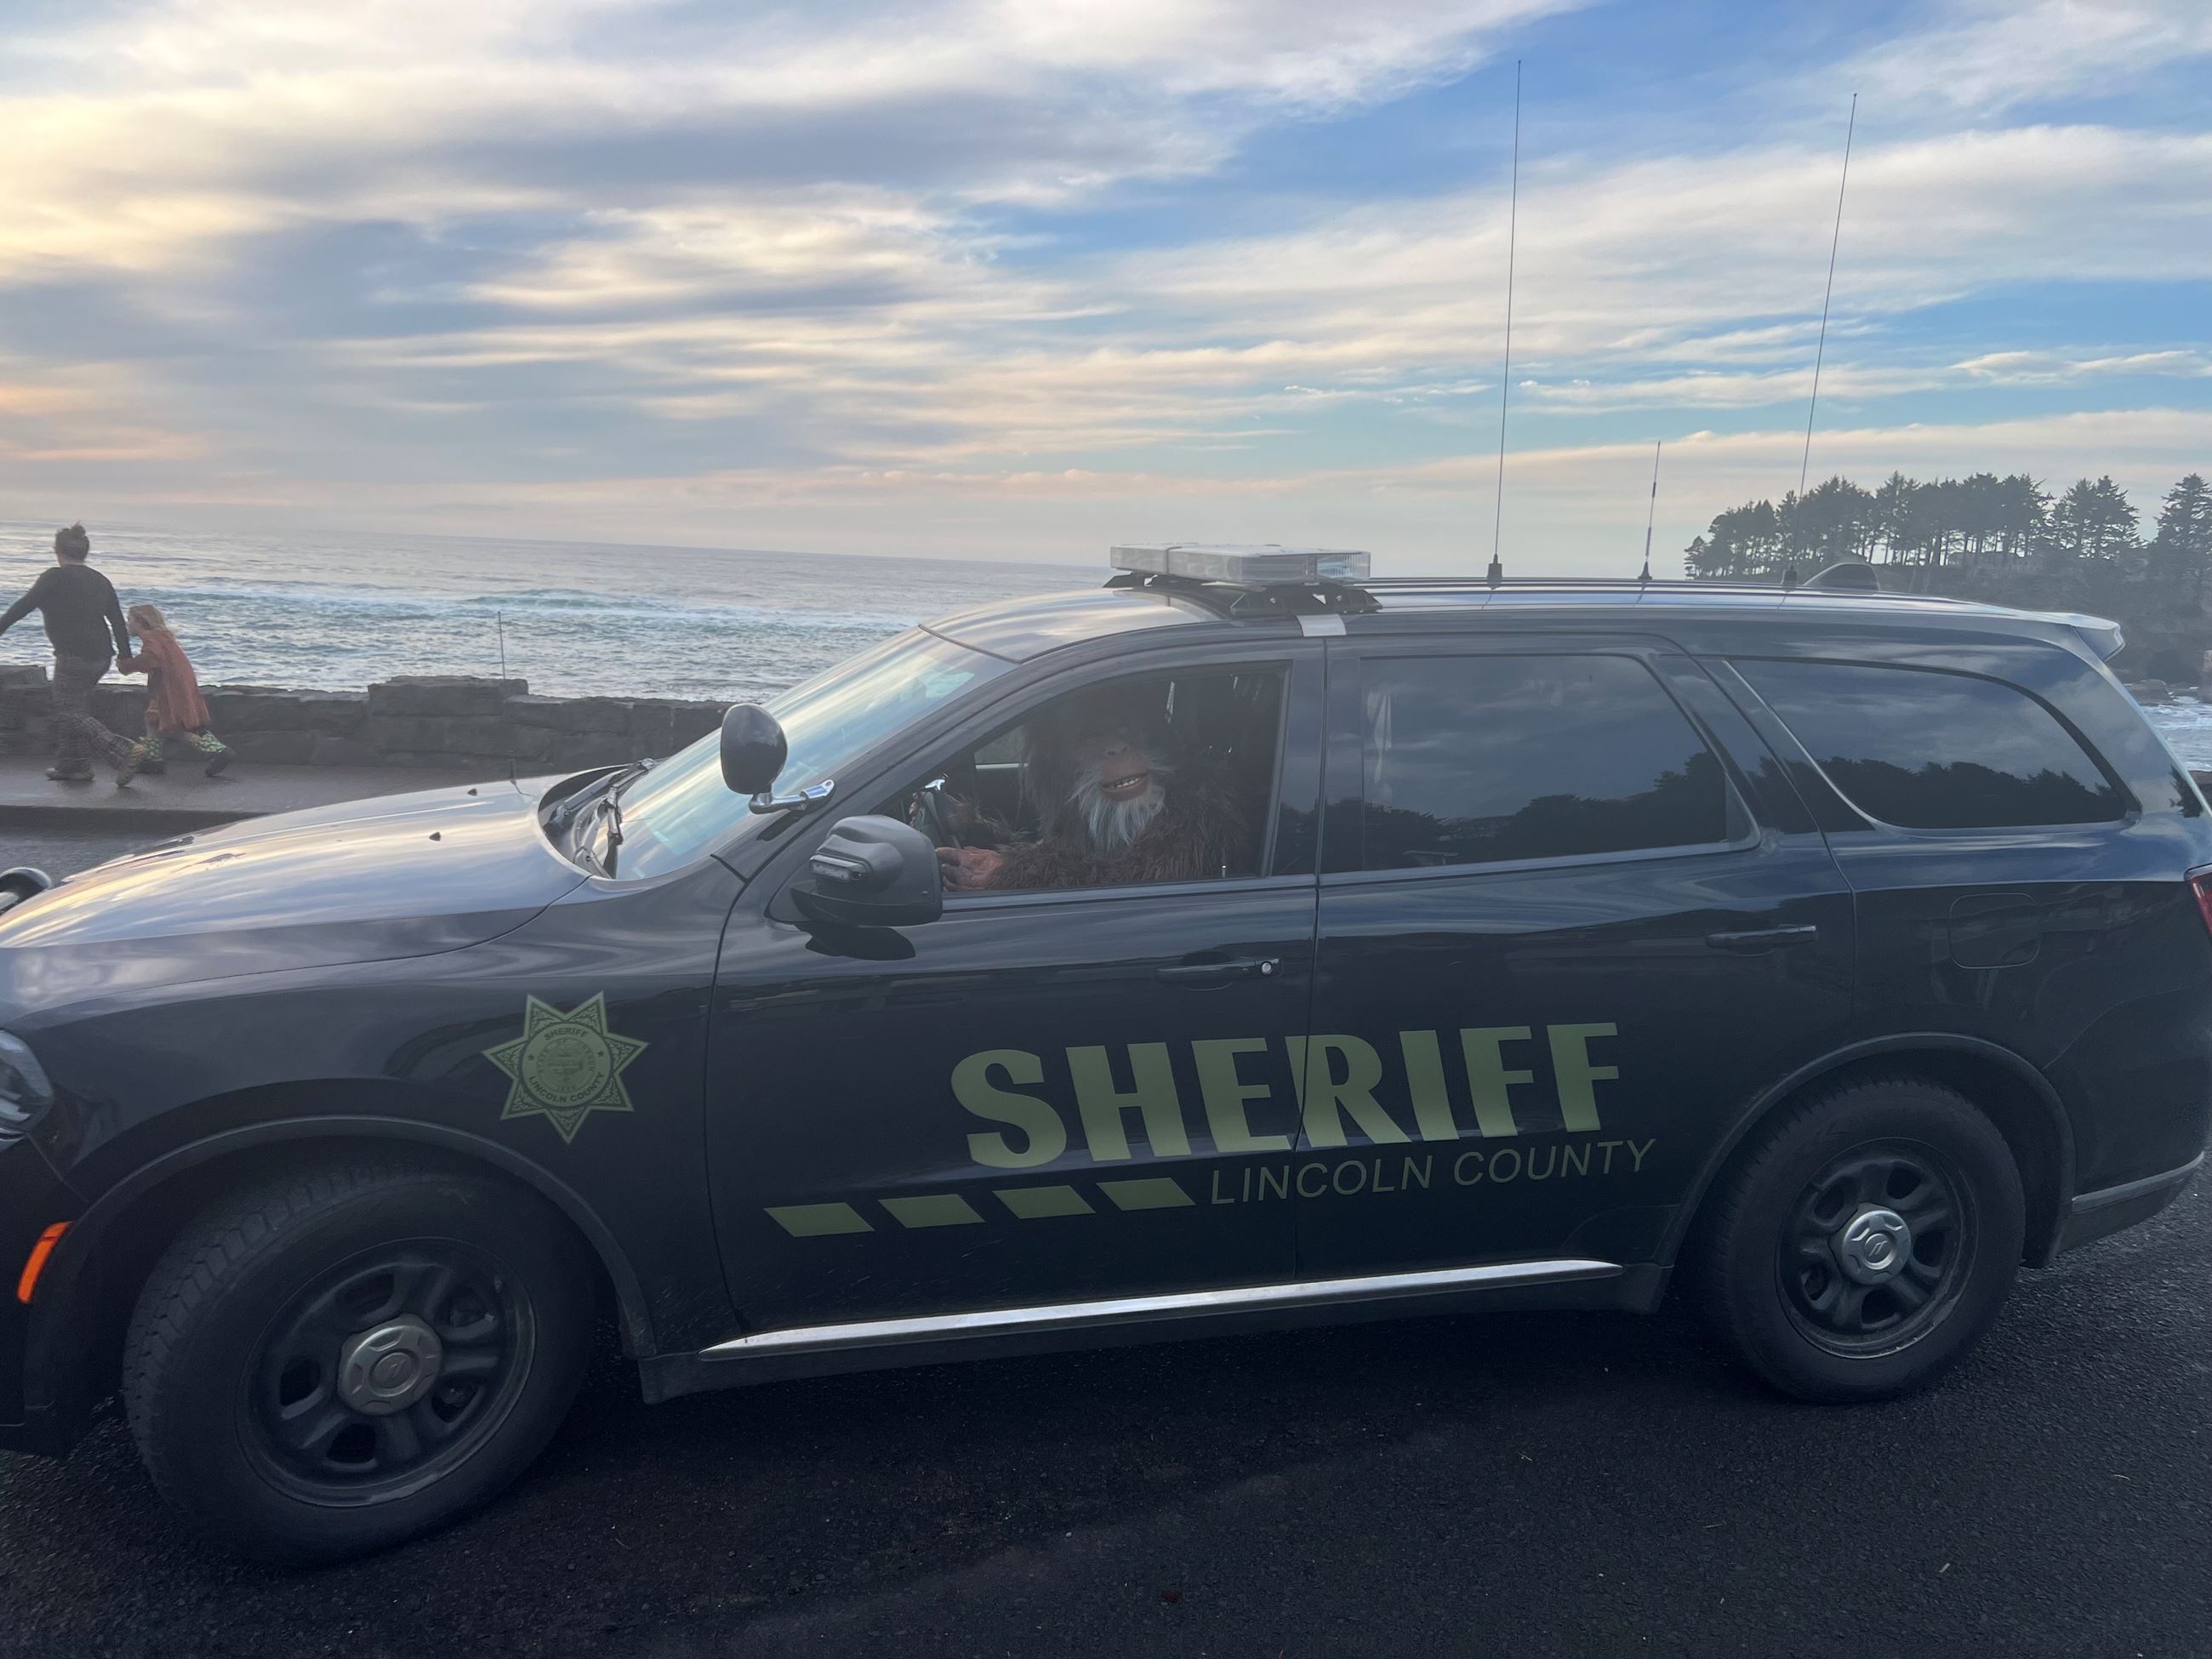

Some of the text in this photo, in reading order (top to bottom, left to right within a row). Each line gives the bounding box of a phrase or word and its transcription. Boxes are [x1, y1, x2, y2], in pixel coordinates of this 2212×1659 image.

[544, 1027, 589, 1040] SHERIFF
[529, 1071, 605, 1103] LINCOLN COUNTY
[950, 1022, 1619, 1168] SHERIFF
[1211, 1137, 1657, 1206] LINCOLN COUNTY
